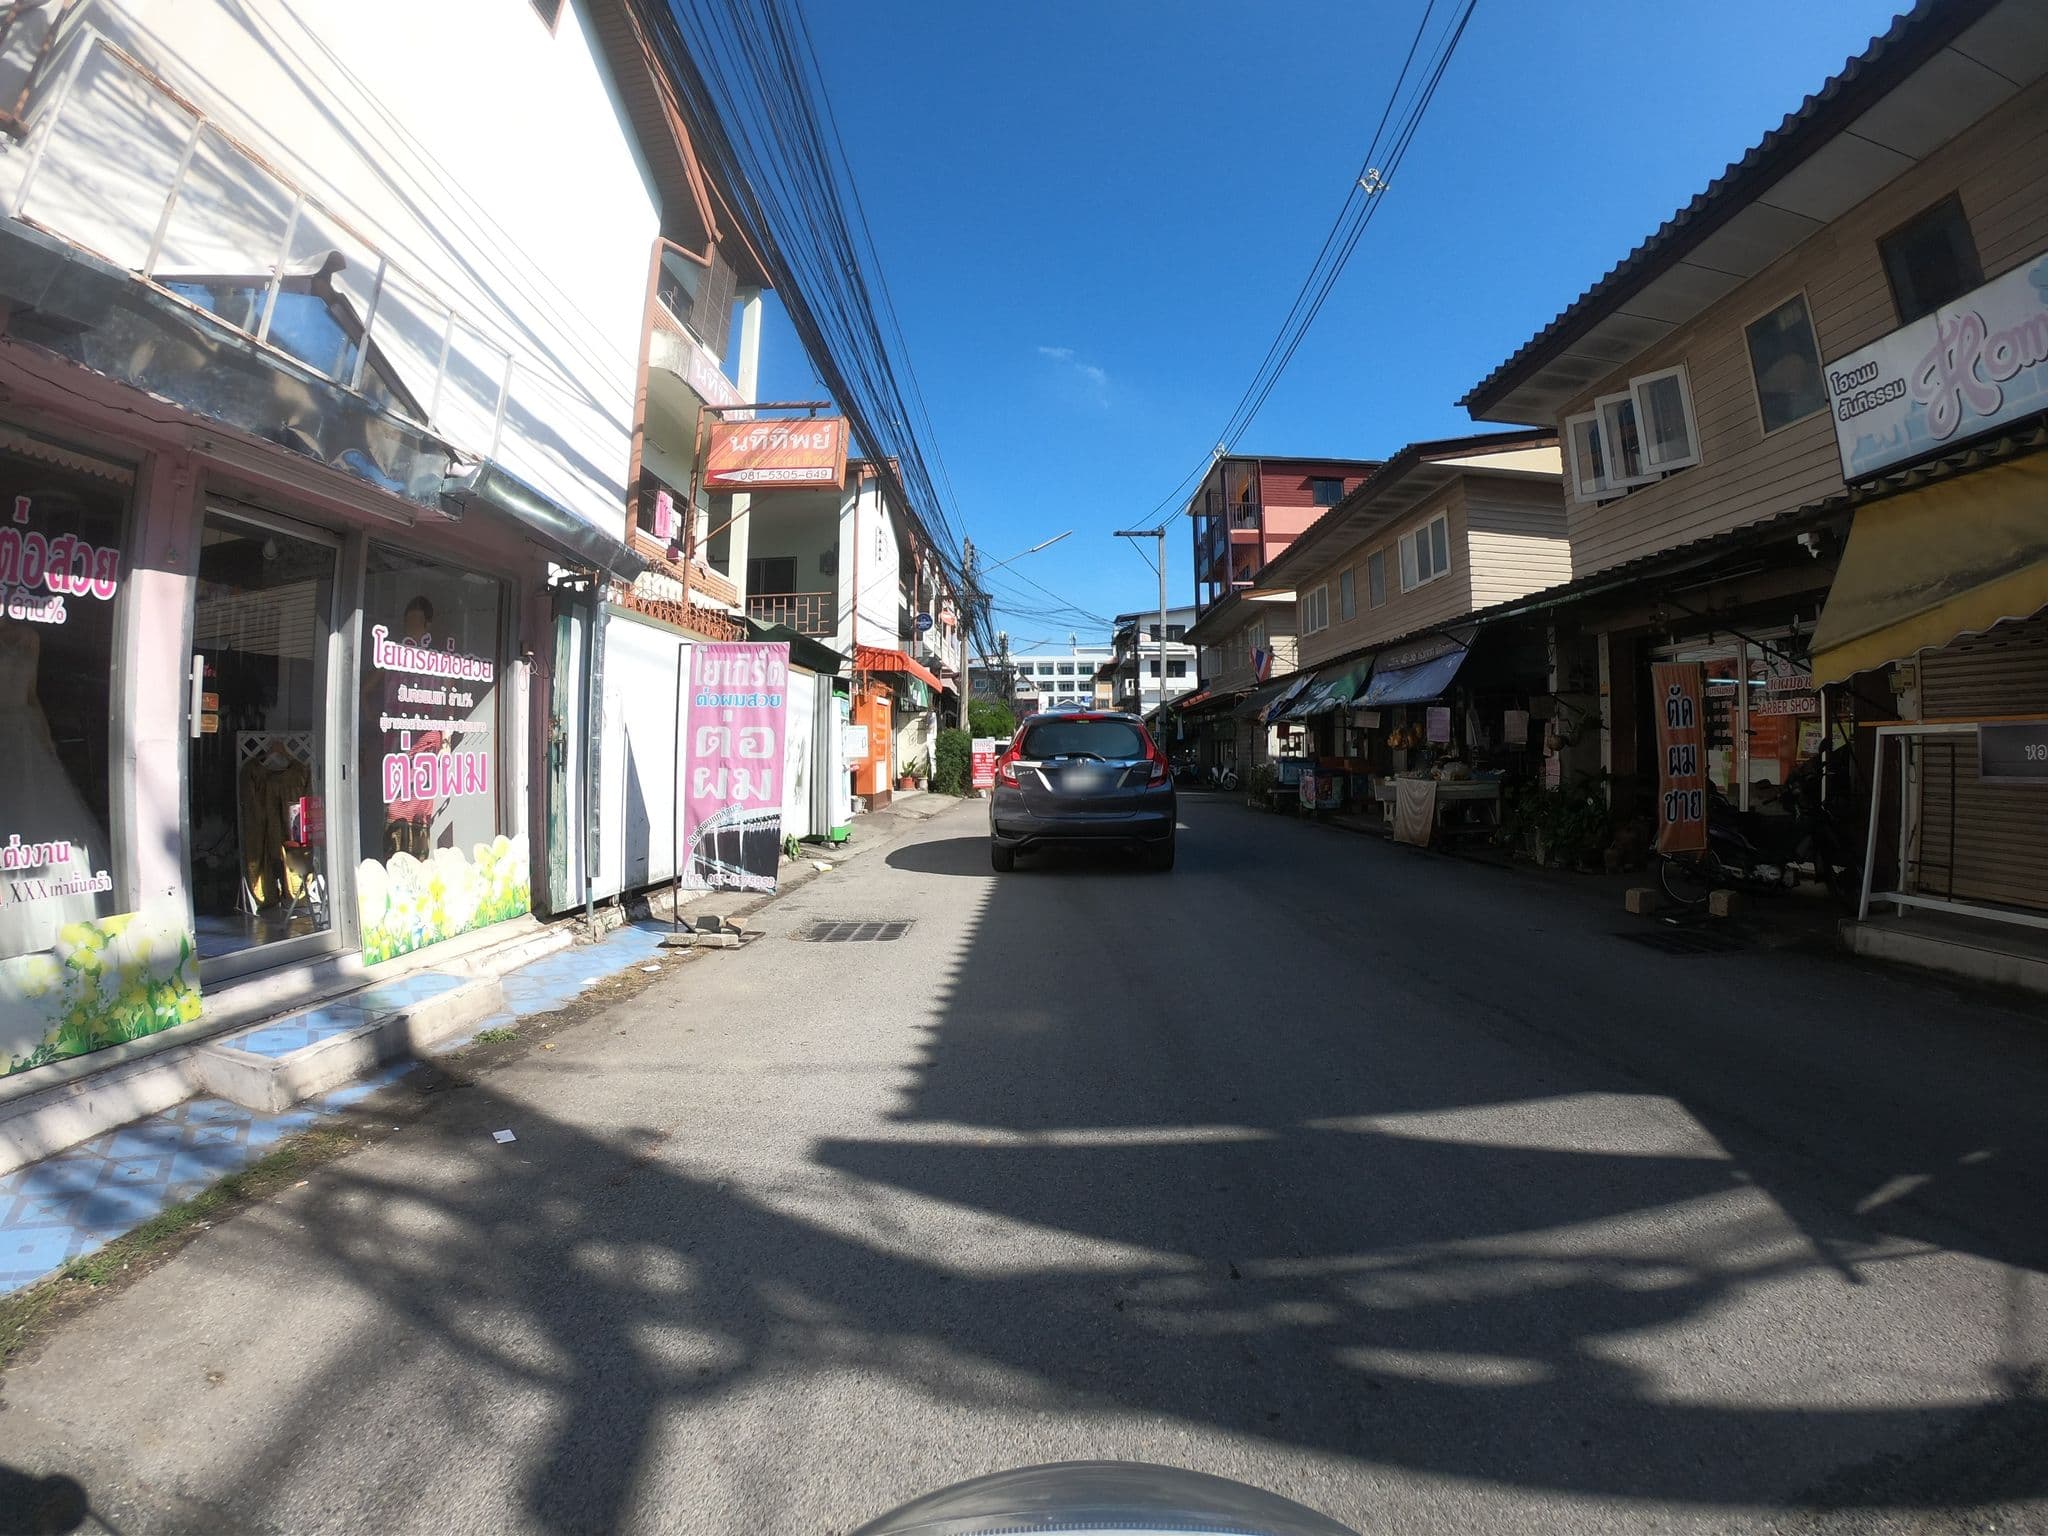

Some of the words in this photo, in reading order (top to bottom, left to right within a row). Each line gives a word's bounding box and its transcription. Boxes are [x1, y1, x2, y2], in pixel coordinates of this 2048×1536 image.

[729, 424, 832, 452] นทีทิพย์
[740, 469, 828, 481] 081-5305-649
[373, 625, 493, 681] โยเกิร์ตต่อสวย
[695, 645, 786, 687] โยเกิร์ต
[695, 688, 783, 708] ต่อผมสวย
[1667, 684, 1694, 729] ตัด
[1758, 701, 1787, 714] BARBER
[1790, 698, 1815, 712] SHOP
[695, 709, 775, 759] ต่อ
[383, 731, 487, 803] ต่อผม
[1668, 744, 1697, 776] ผม
[693, 767, 772, 800] ผม
[1664, 789, 1703, 823] ชาย
